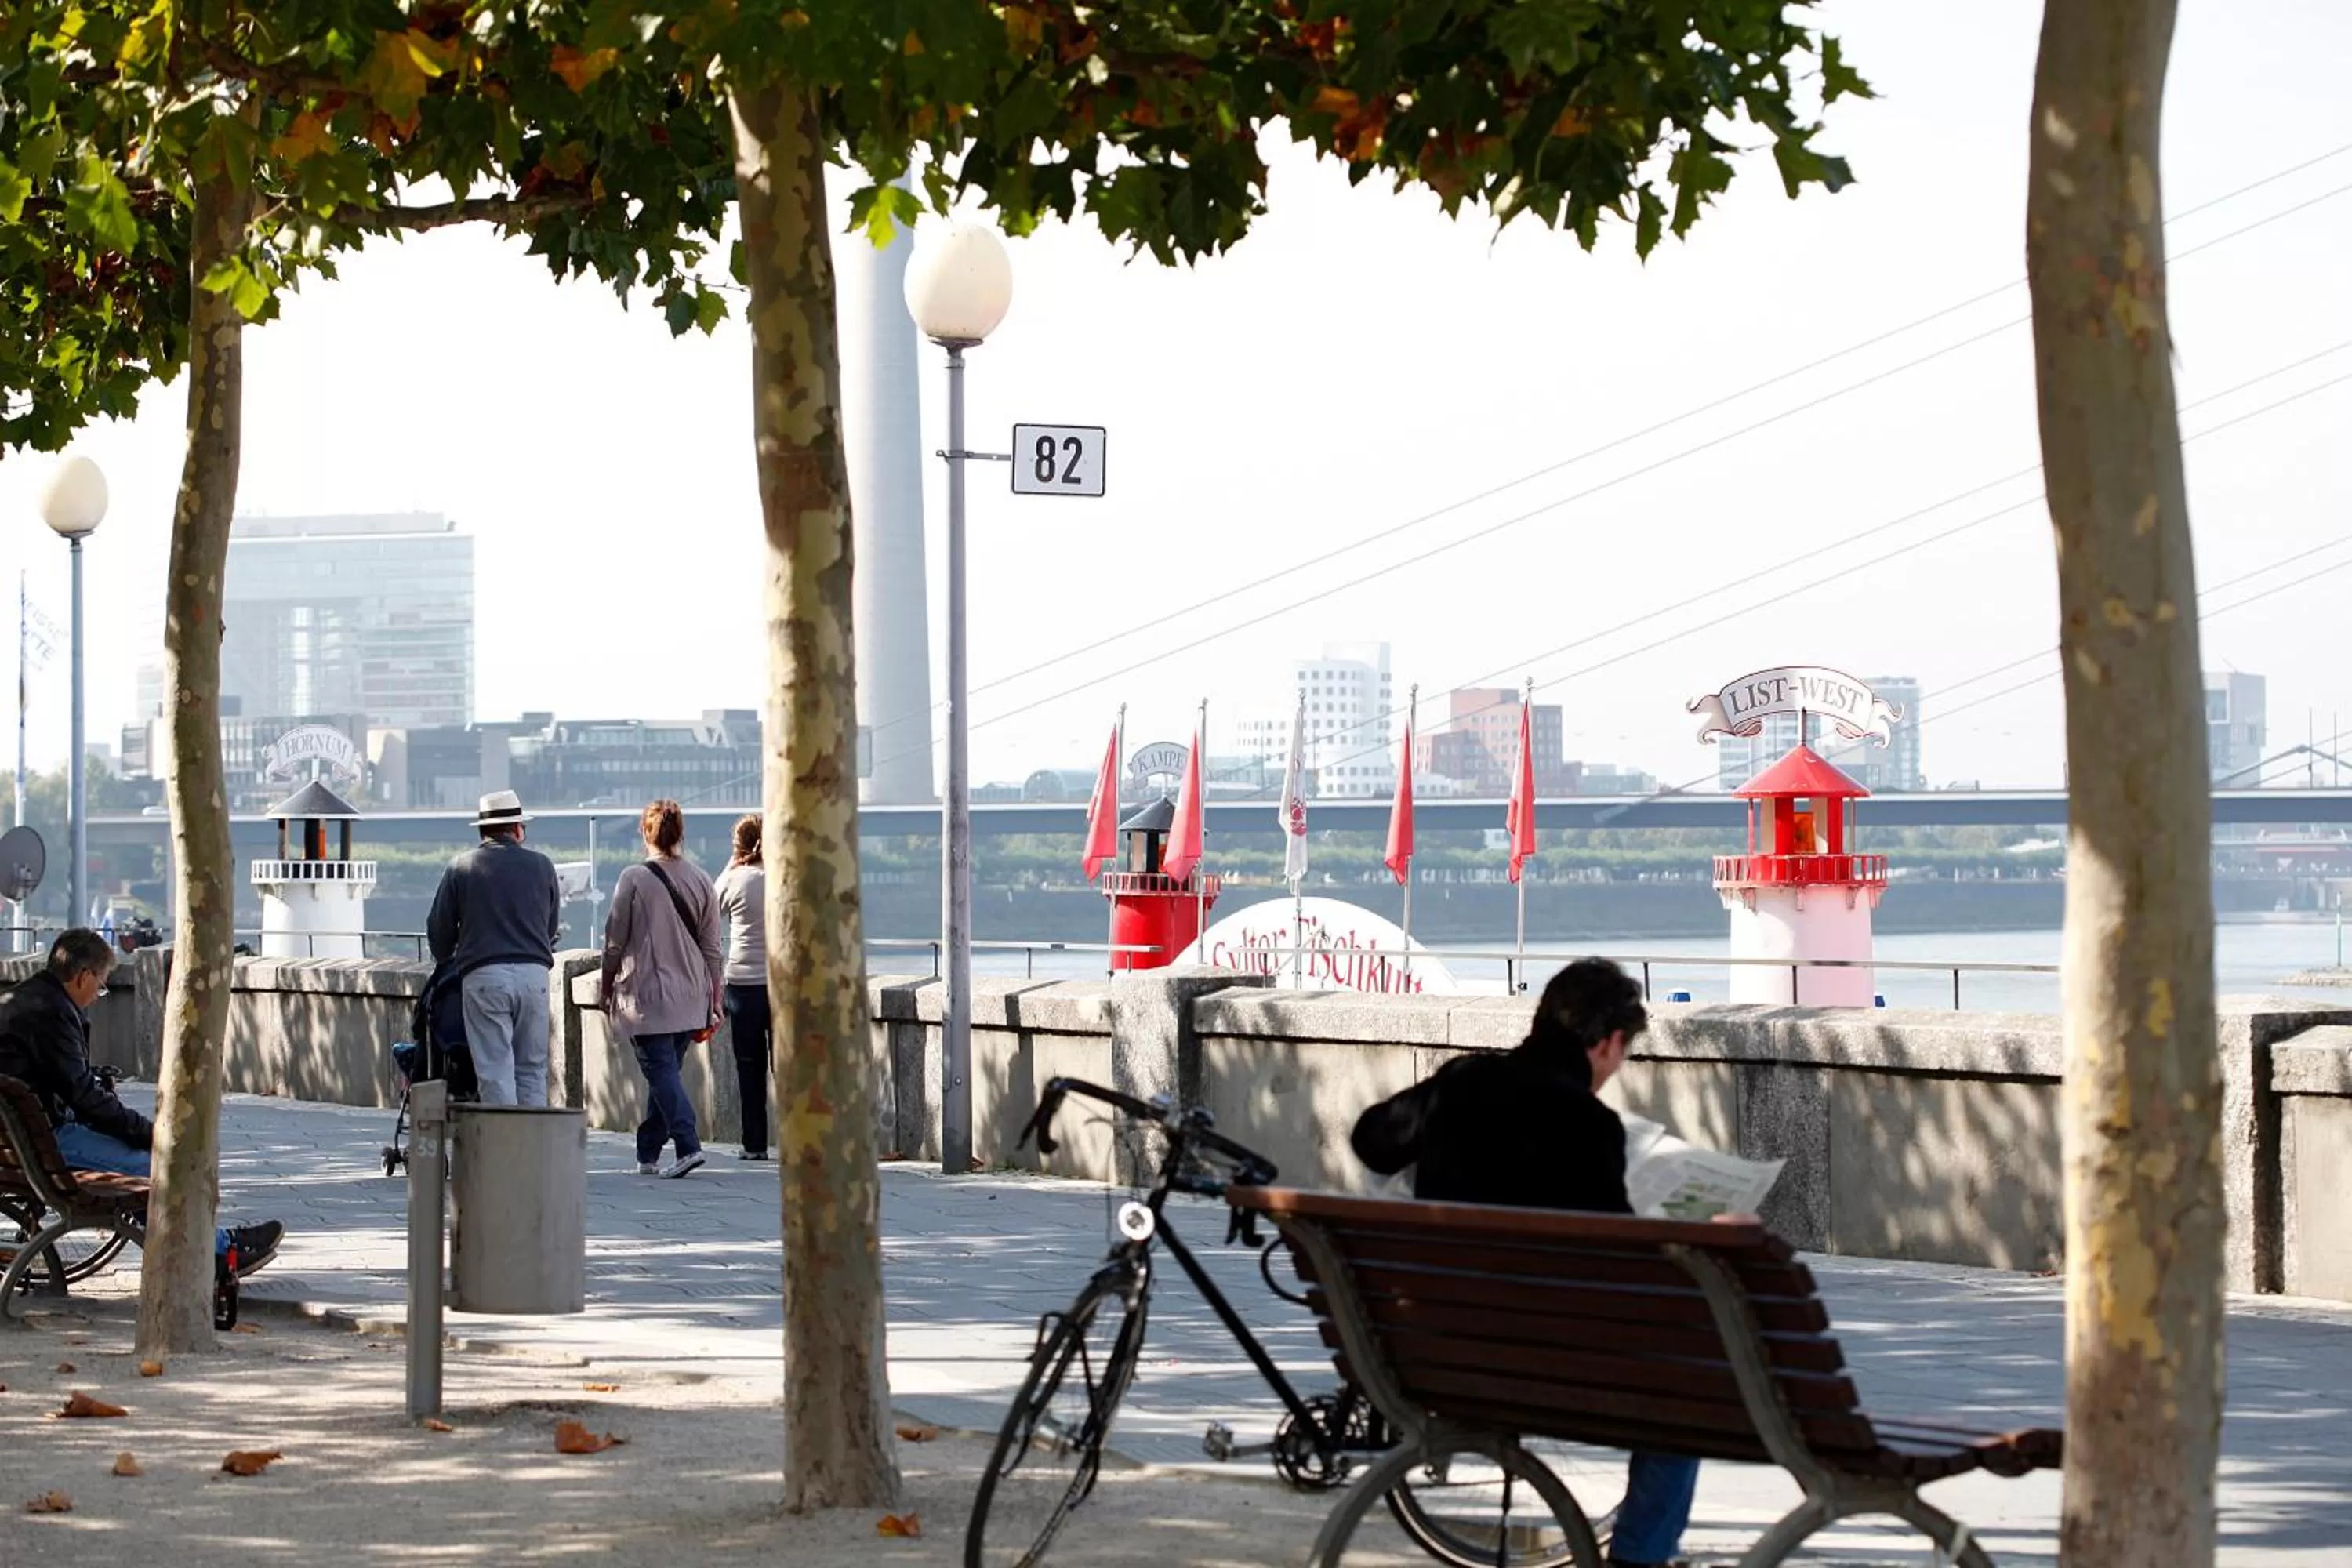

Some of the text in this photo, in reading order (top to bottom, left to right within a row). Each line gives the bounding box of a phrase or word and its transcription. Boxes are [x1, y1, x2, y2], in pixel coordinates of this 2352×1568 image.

[1035, 435, 1083, 485] 82
[1729, 677, 1864, 715] LIST-WEST
[1137, 750, 1189, 773] KAMPE
[416, 1137, 437, 1157] 39
